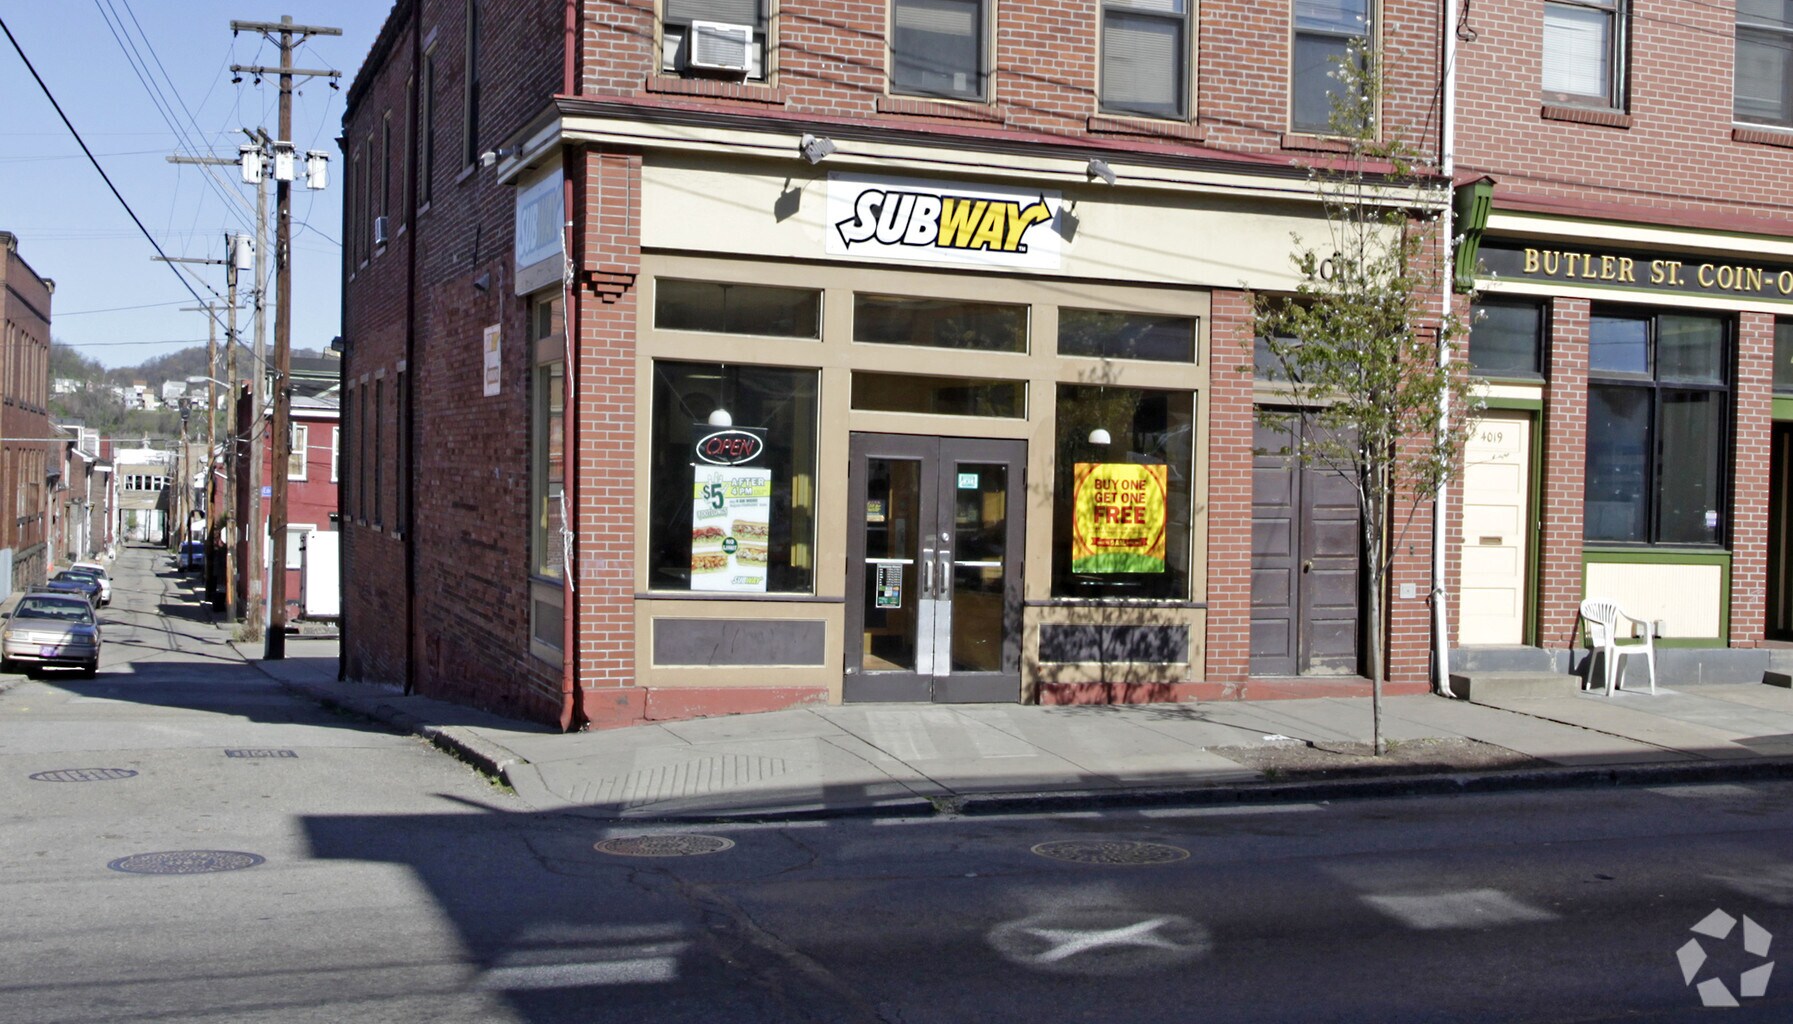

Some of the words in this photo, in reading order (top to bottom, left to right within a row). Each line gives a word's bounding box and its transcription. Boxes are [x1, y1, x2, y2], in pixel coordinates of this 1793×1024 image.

[836, 189, 1053, 253] SUBWAY
[1524, 248, 1635, 283] BUTLER
[1651, 260, 1685, 286] ST.
[1697, 263, 1793, 296] COIN-O
[1481, 432, 1503, 444] 4019
[706, 437, 755, 456] OPEN
[731, 477, 765, 487] AFTER
[1094, 479, 1119, 490] BUY
[1121, 479, 1146, 490] ONE
[702, 483, 724, 509] $5
[731, 487, 738, 496] 4
[739, 487, 753, 495] PM
[1094, 492, 1118, 503] GET
[1121, 493, 1146, 504] ONE
[1094, 506, 1146, 524] FREE
